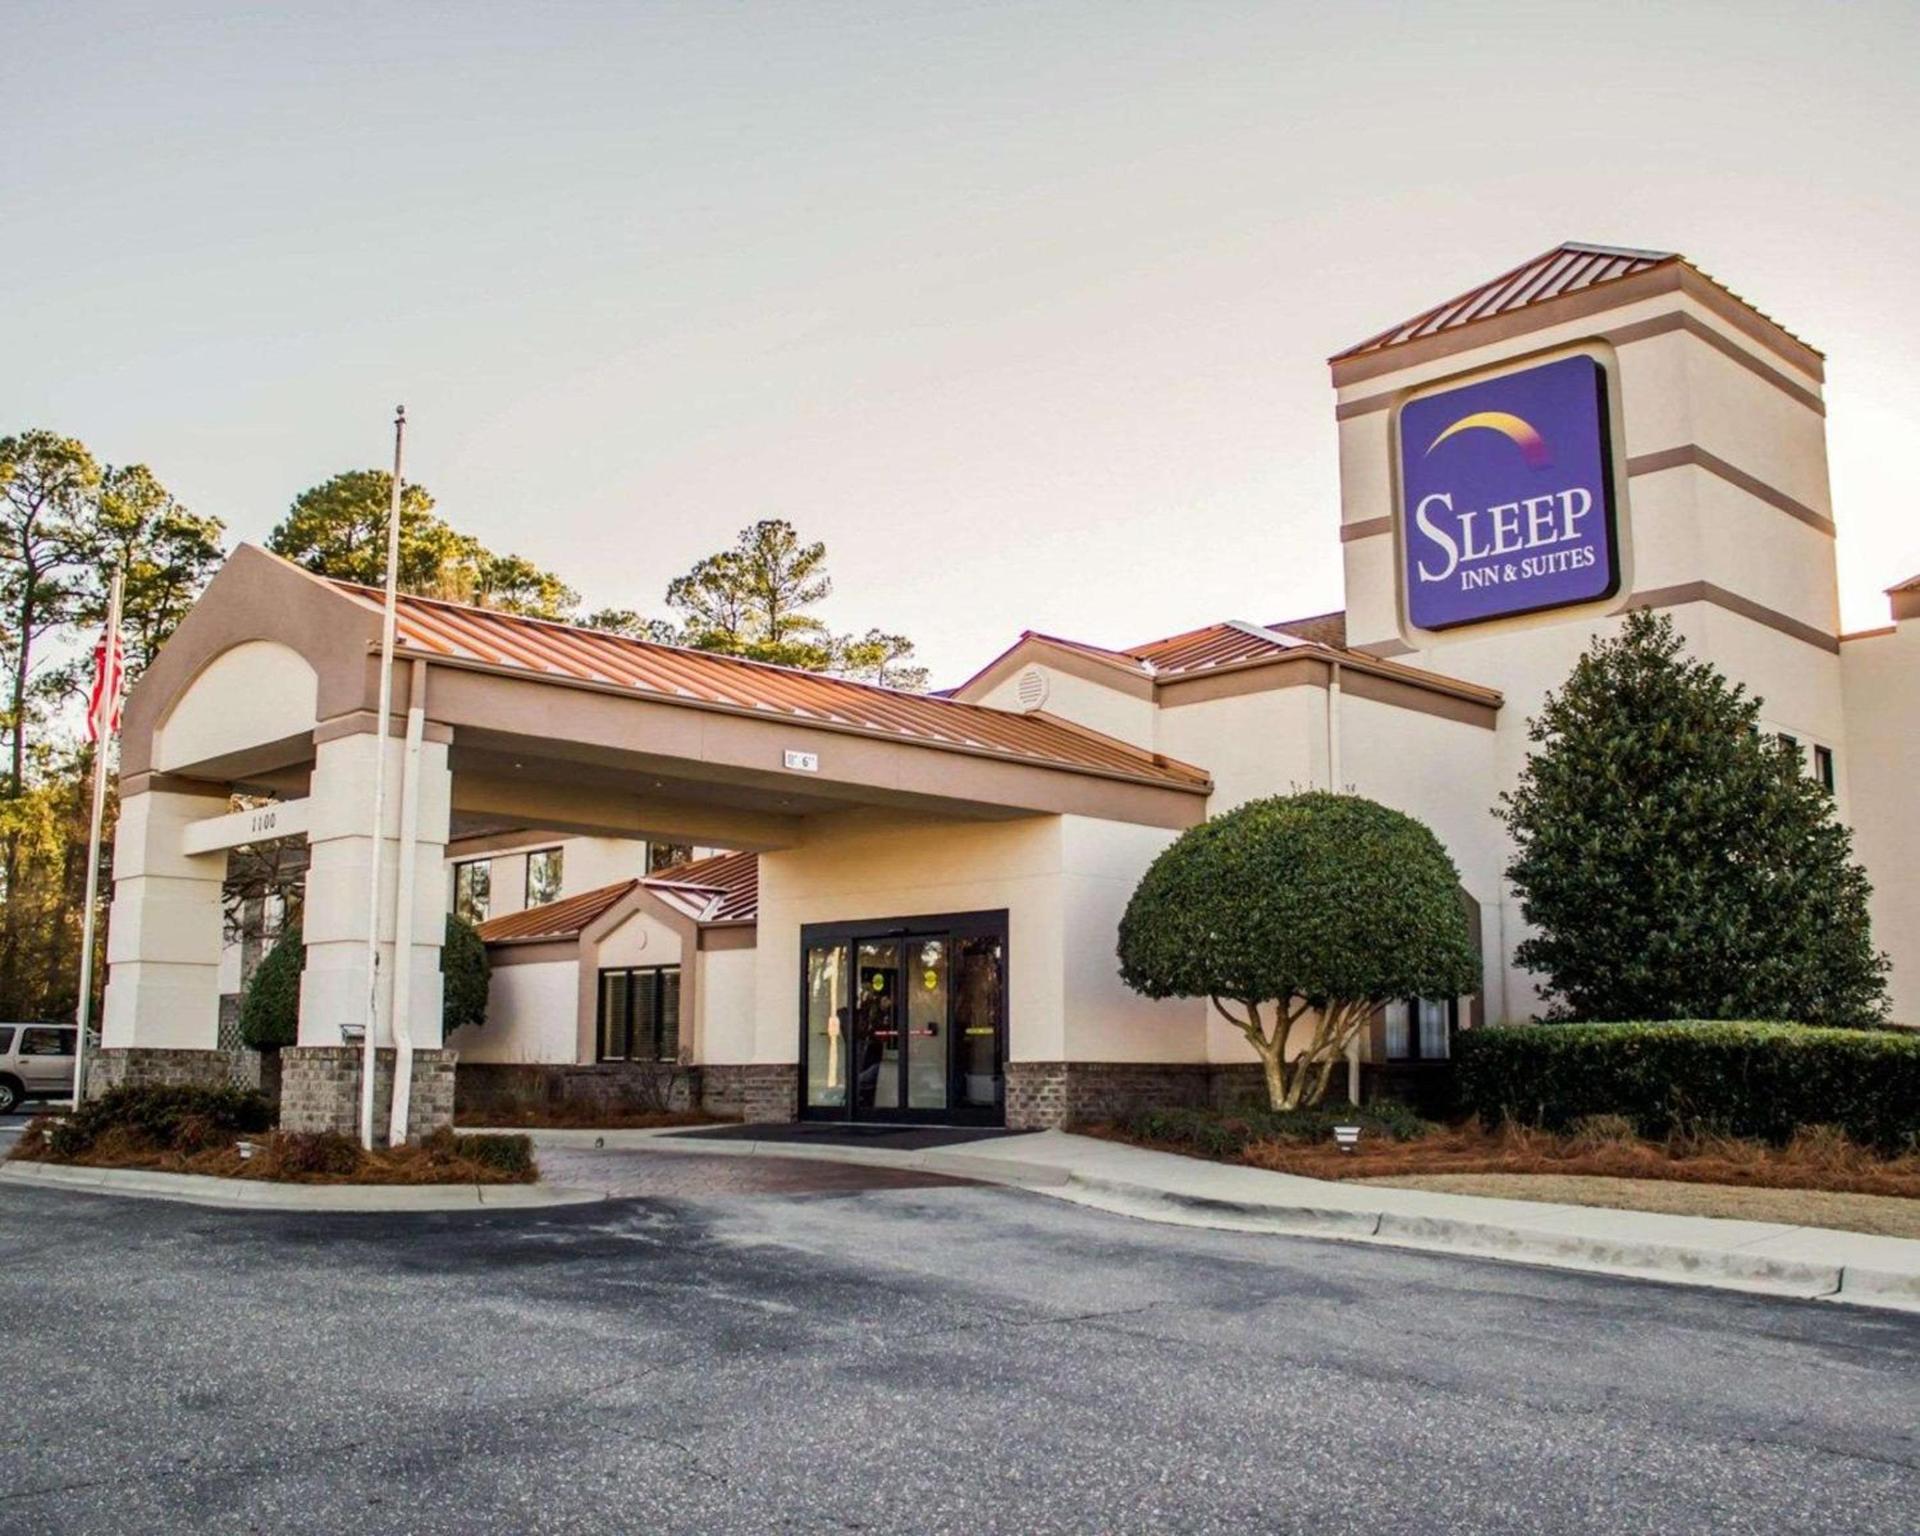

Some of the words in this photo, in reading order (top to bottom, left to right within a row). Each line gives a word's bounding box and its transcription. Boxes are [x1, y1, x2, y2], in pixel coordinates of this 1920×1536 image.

[1415, 487, 1592, 581] SLEEP
[1461, 566, 1499, 591] INN
[1503, 564, 1517, 582] &
[1521, 546, 1595, 579] SUITES
[252, 812, 276, 832] 1100
